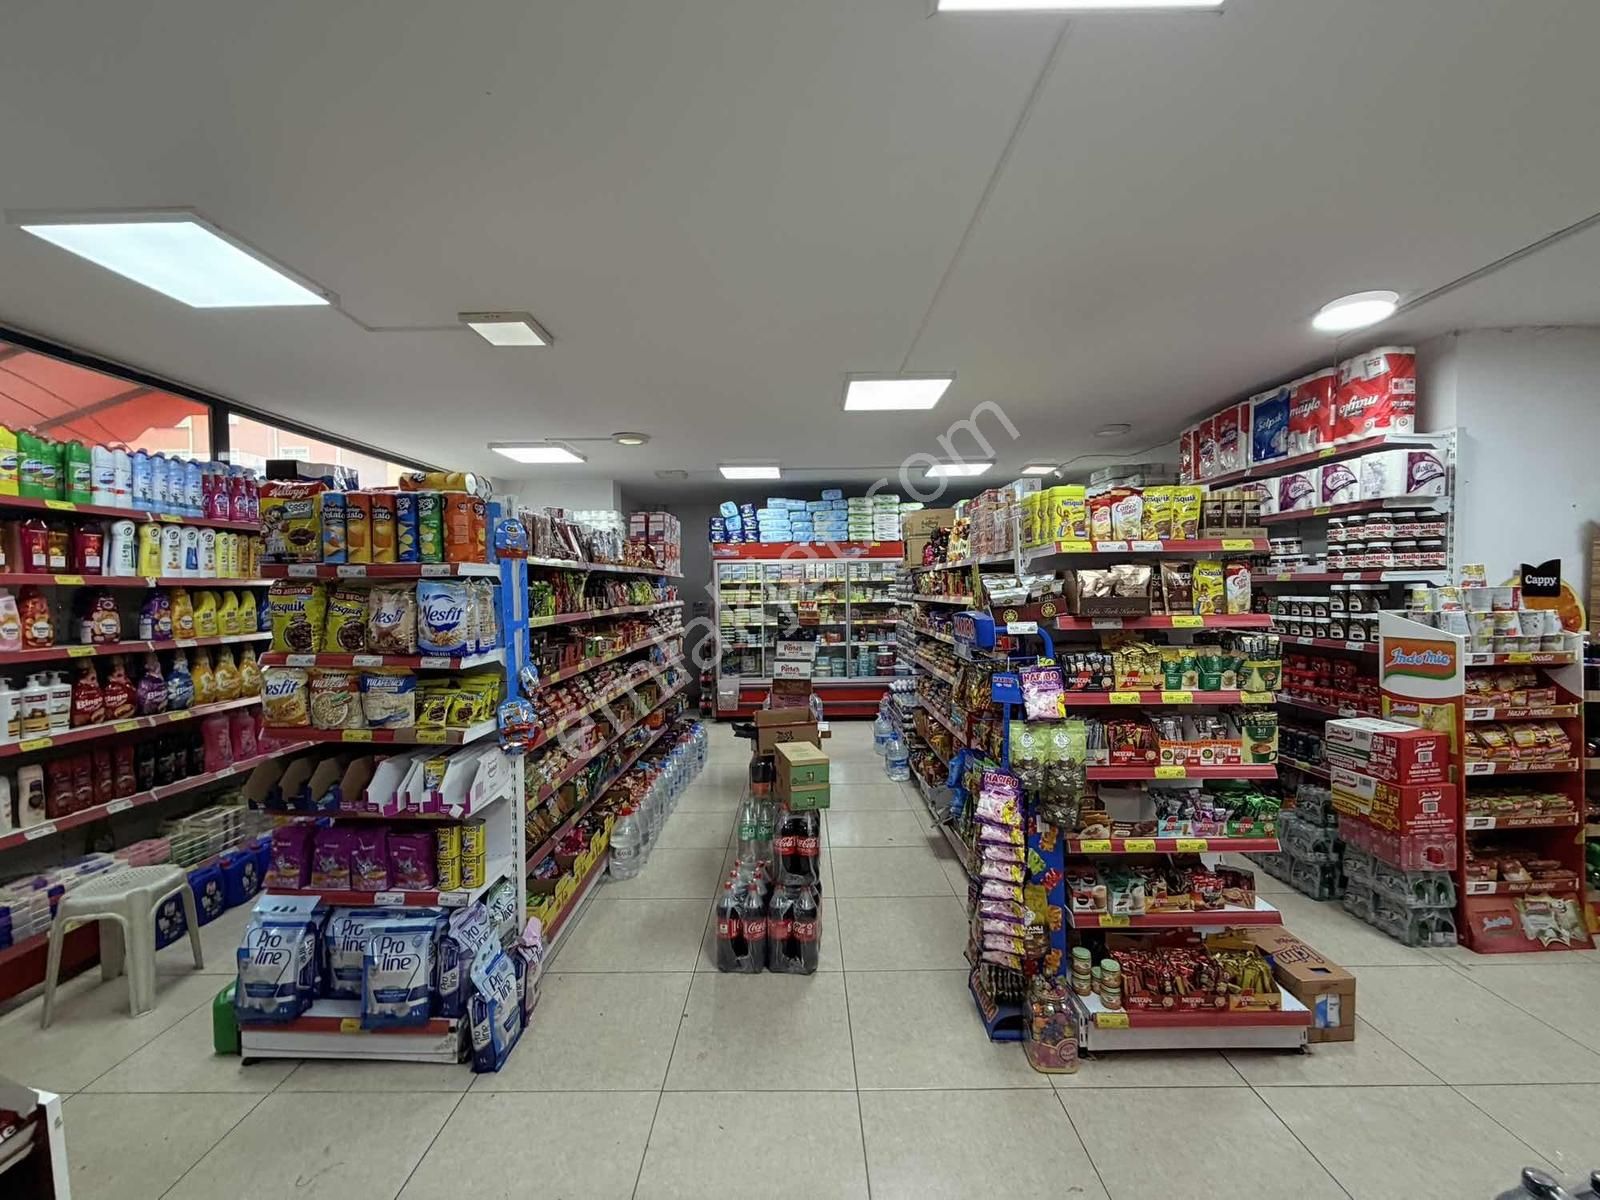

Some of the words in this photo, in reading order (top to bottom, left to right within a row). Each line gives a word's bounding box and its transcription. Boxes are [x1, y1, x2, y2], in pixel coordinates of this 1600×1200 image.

[1525, 575, 1557, 587] Cappy
[422, 605, 464, 623] Nesfit
[1023, 671, 1059, 682] HARIBO
[265, 680, 298, 696] esfit
[985, 773, 1018, 788] HARIBO
[256, 930, 282, 948] Pro
[462, 924, 480, 944] Pro
[381, 936, 405, 955] Pro
[254, 946, 282, 966] line
[382, 953, 412, 972] line
